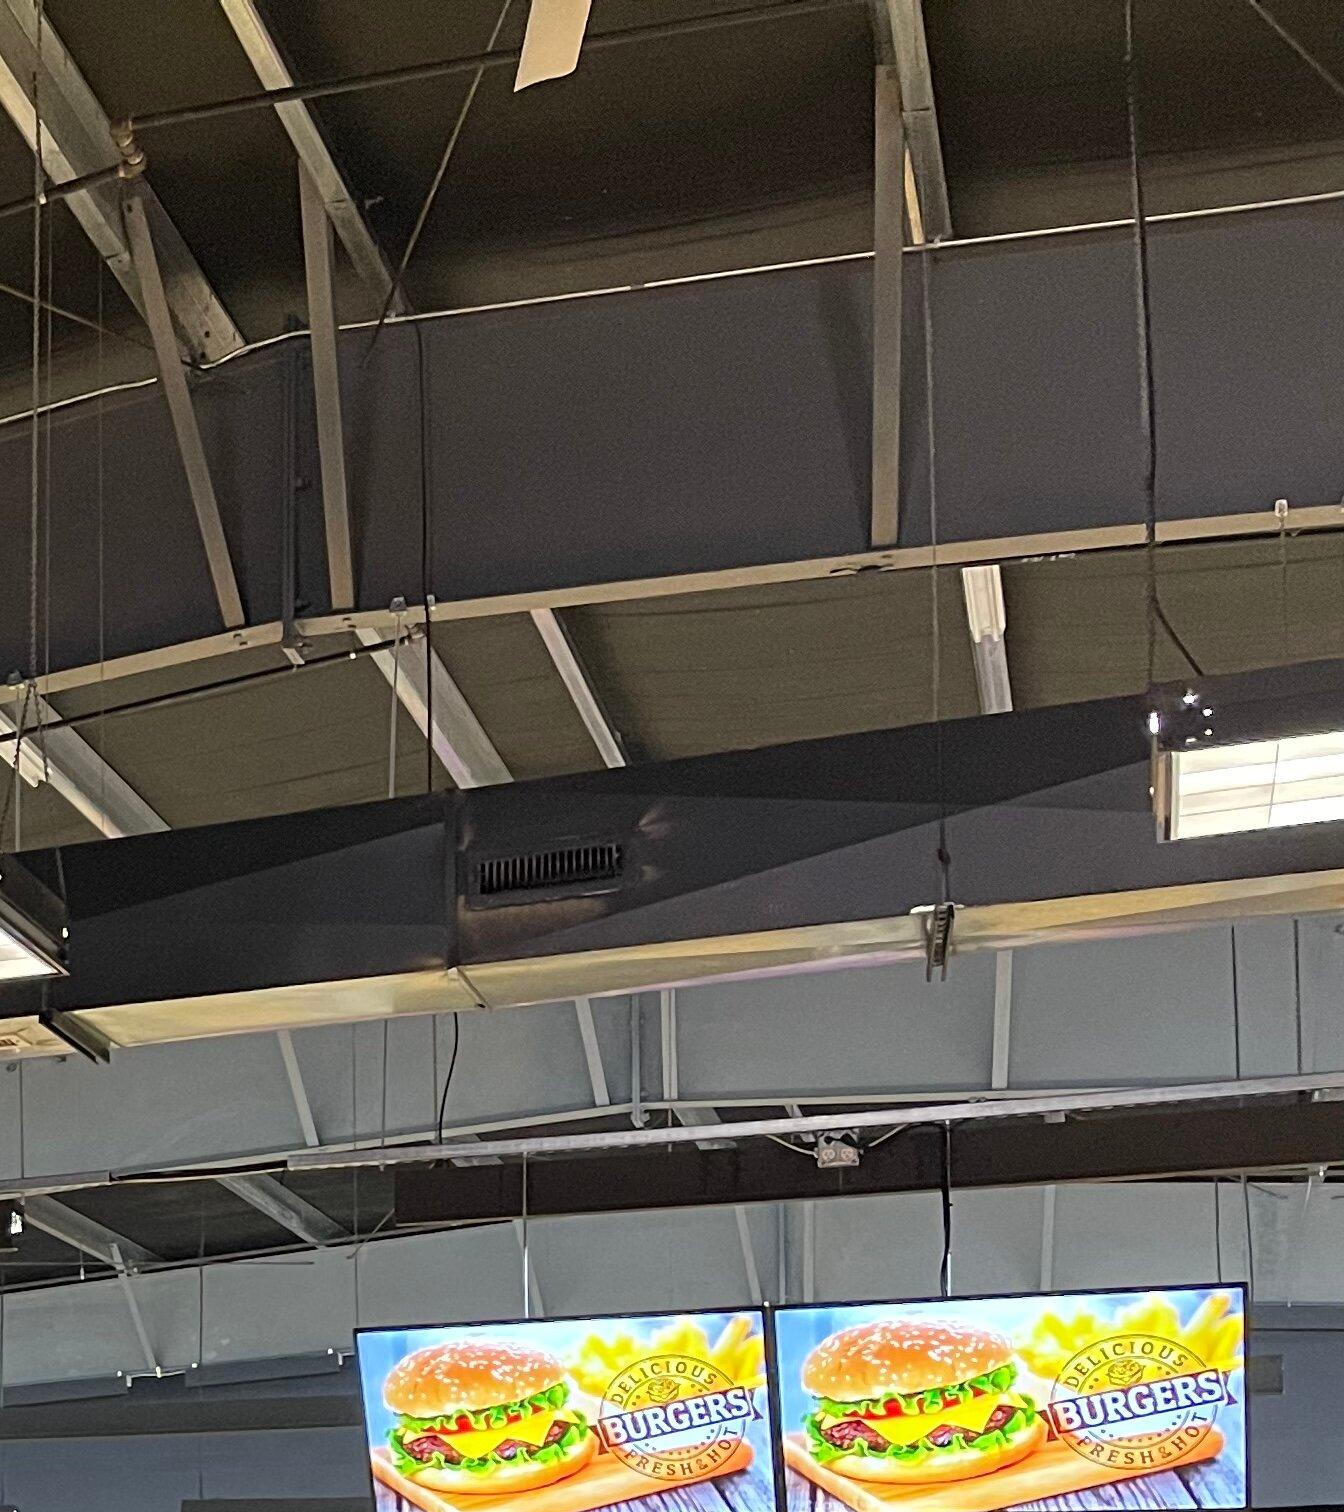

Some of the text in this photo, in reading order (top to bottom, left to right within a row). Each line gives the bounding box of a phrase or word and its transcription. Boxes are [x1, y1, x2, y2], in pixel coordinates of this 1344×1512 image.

[611, 1361, 718, 1405] DELICIOUS
[1063, 1341, 1189, 1388] DELICIOUS
[604, 1388, 750, 1445] BURGERS
[1052, 1370, 1223, 1431] BURGERS
